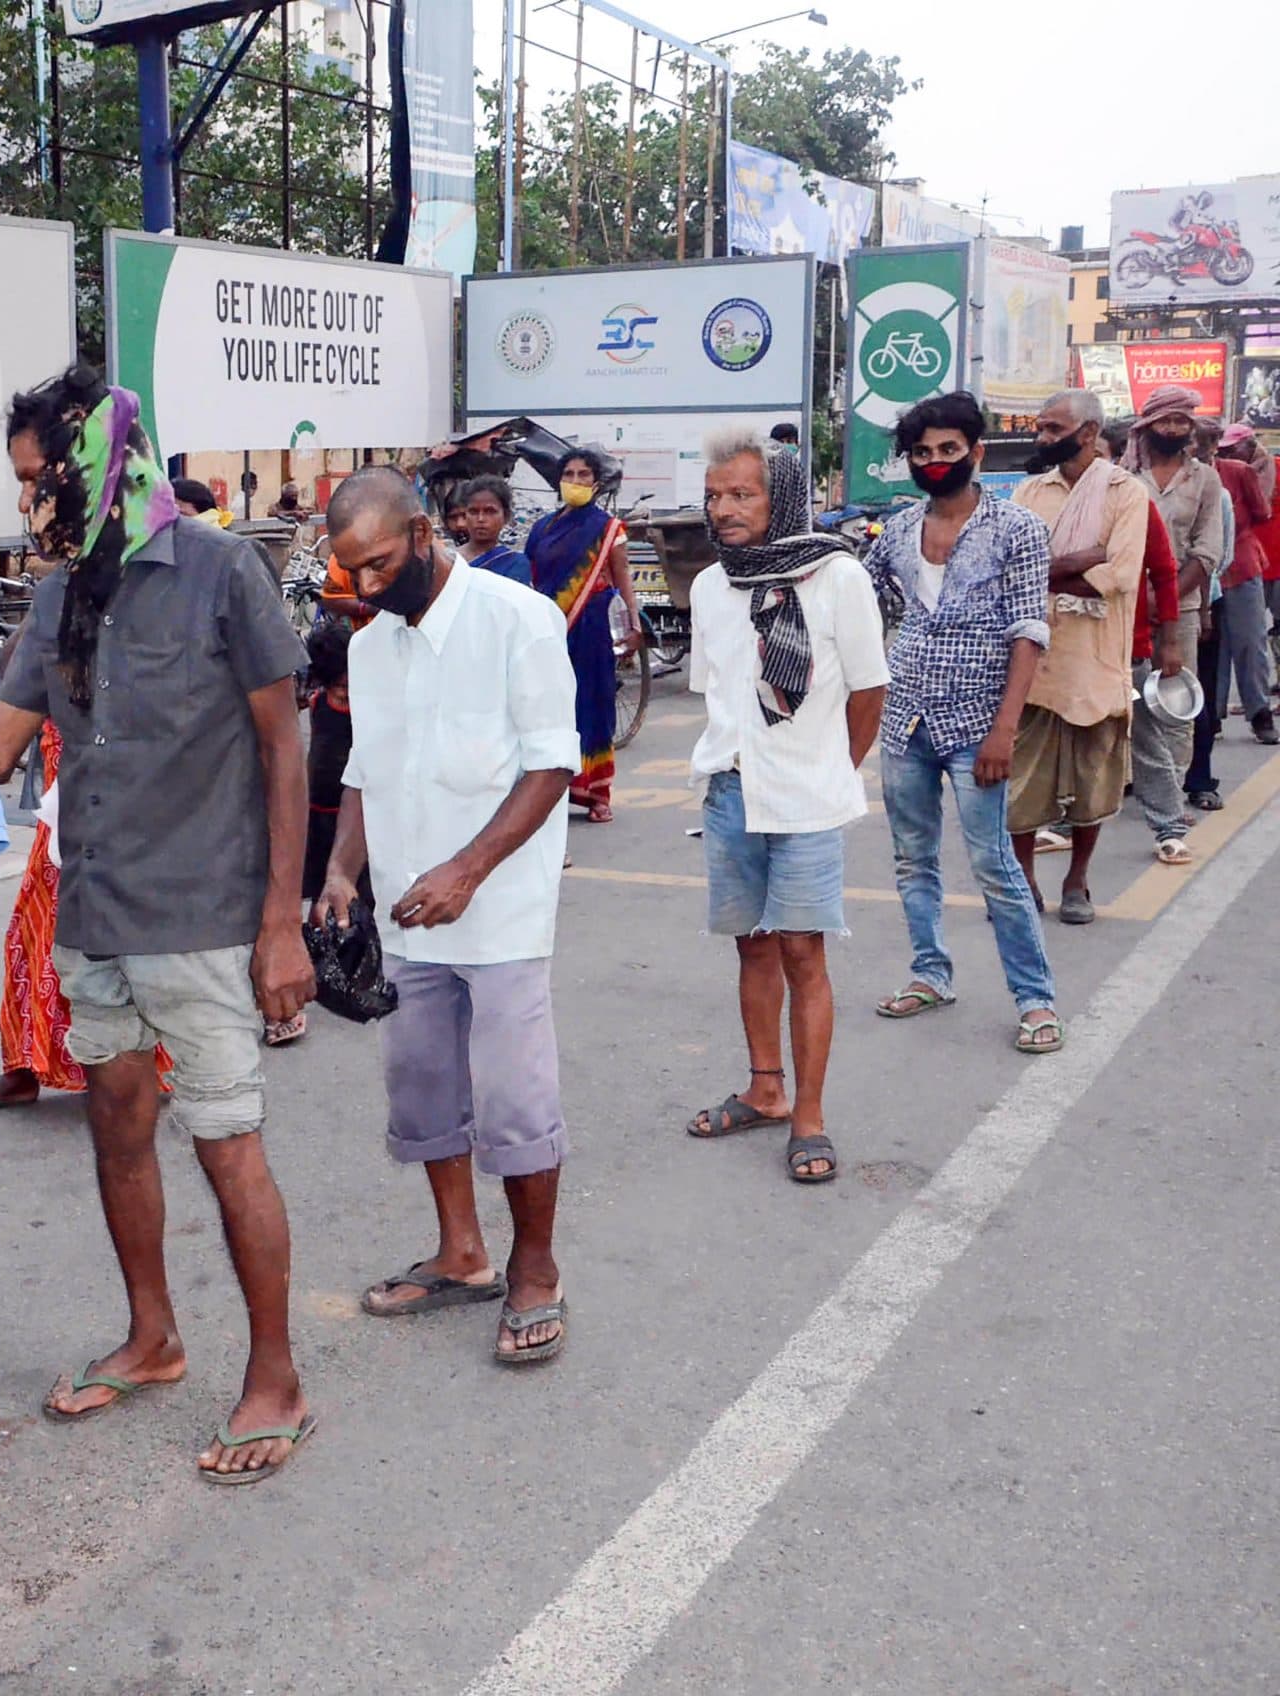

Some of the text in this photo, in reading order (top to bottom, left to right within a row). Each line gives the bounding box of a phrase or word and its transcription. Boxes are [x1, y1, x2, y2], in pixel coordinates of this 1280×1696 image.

[216, 279, 384, 334] GET MORE OUT OF
[223, 337, 277, 382] YOUR
